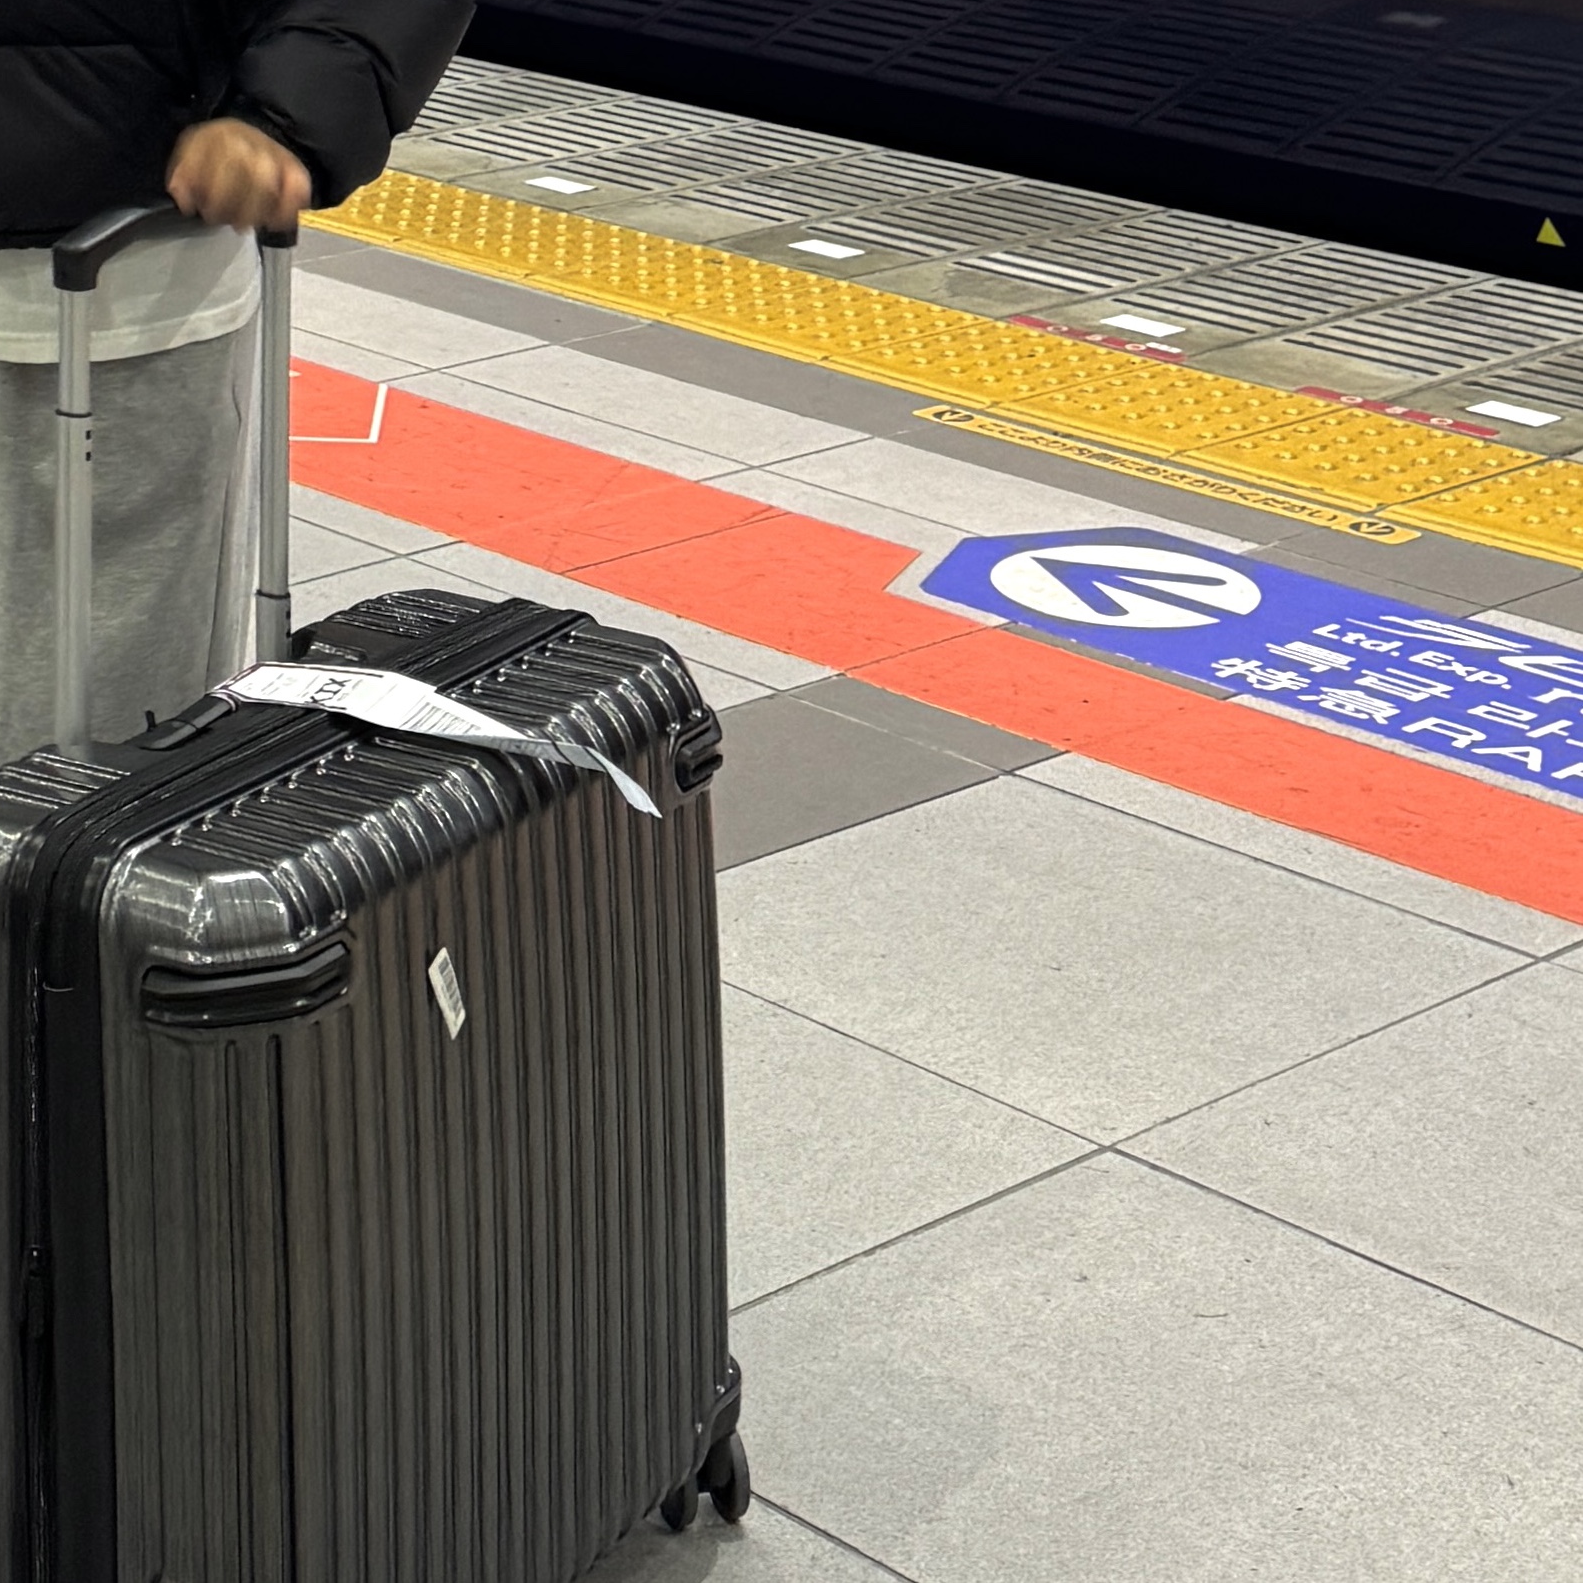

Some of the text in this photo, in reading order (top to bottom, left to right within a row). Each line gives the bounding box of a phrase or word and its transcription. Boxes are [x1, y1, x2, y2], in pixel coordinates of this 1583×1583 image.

[1311, 623, 1401, 658] Ltd.
[1408, 649, 1512, 690] Exp.
[1467, 700, 1583, 747] 라
